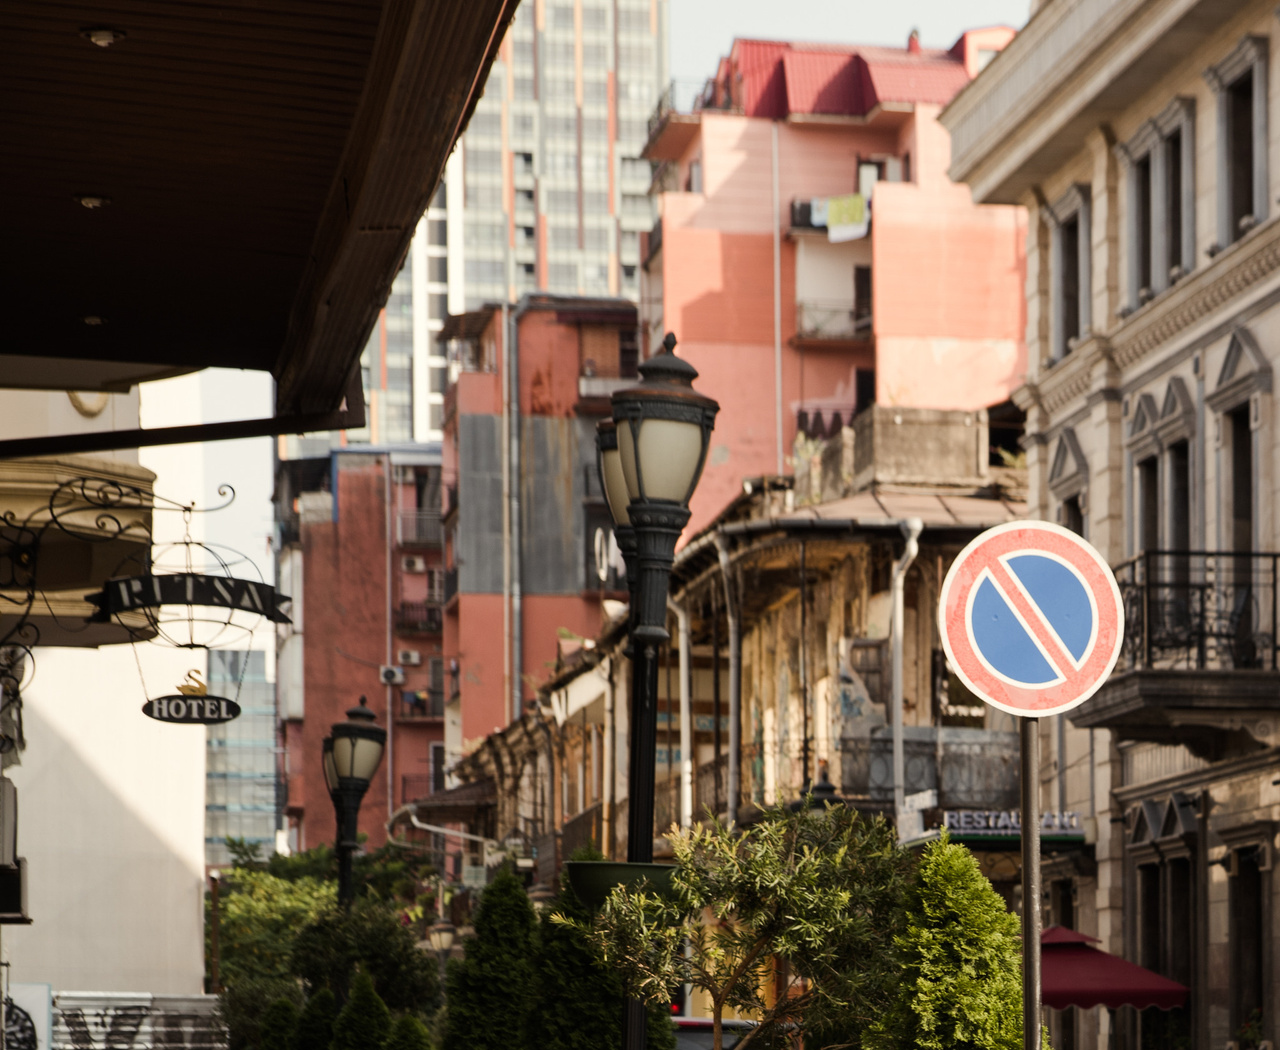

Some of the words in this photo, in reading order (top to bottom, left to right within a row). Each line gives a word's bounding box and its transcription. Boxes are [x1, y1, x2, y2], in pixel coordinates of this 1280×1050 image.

[117, 574, 264, 612] RITSA
[152, 699, 233, 720] HOTEL
[943, 809, 1082, 830] RESTAUANT
